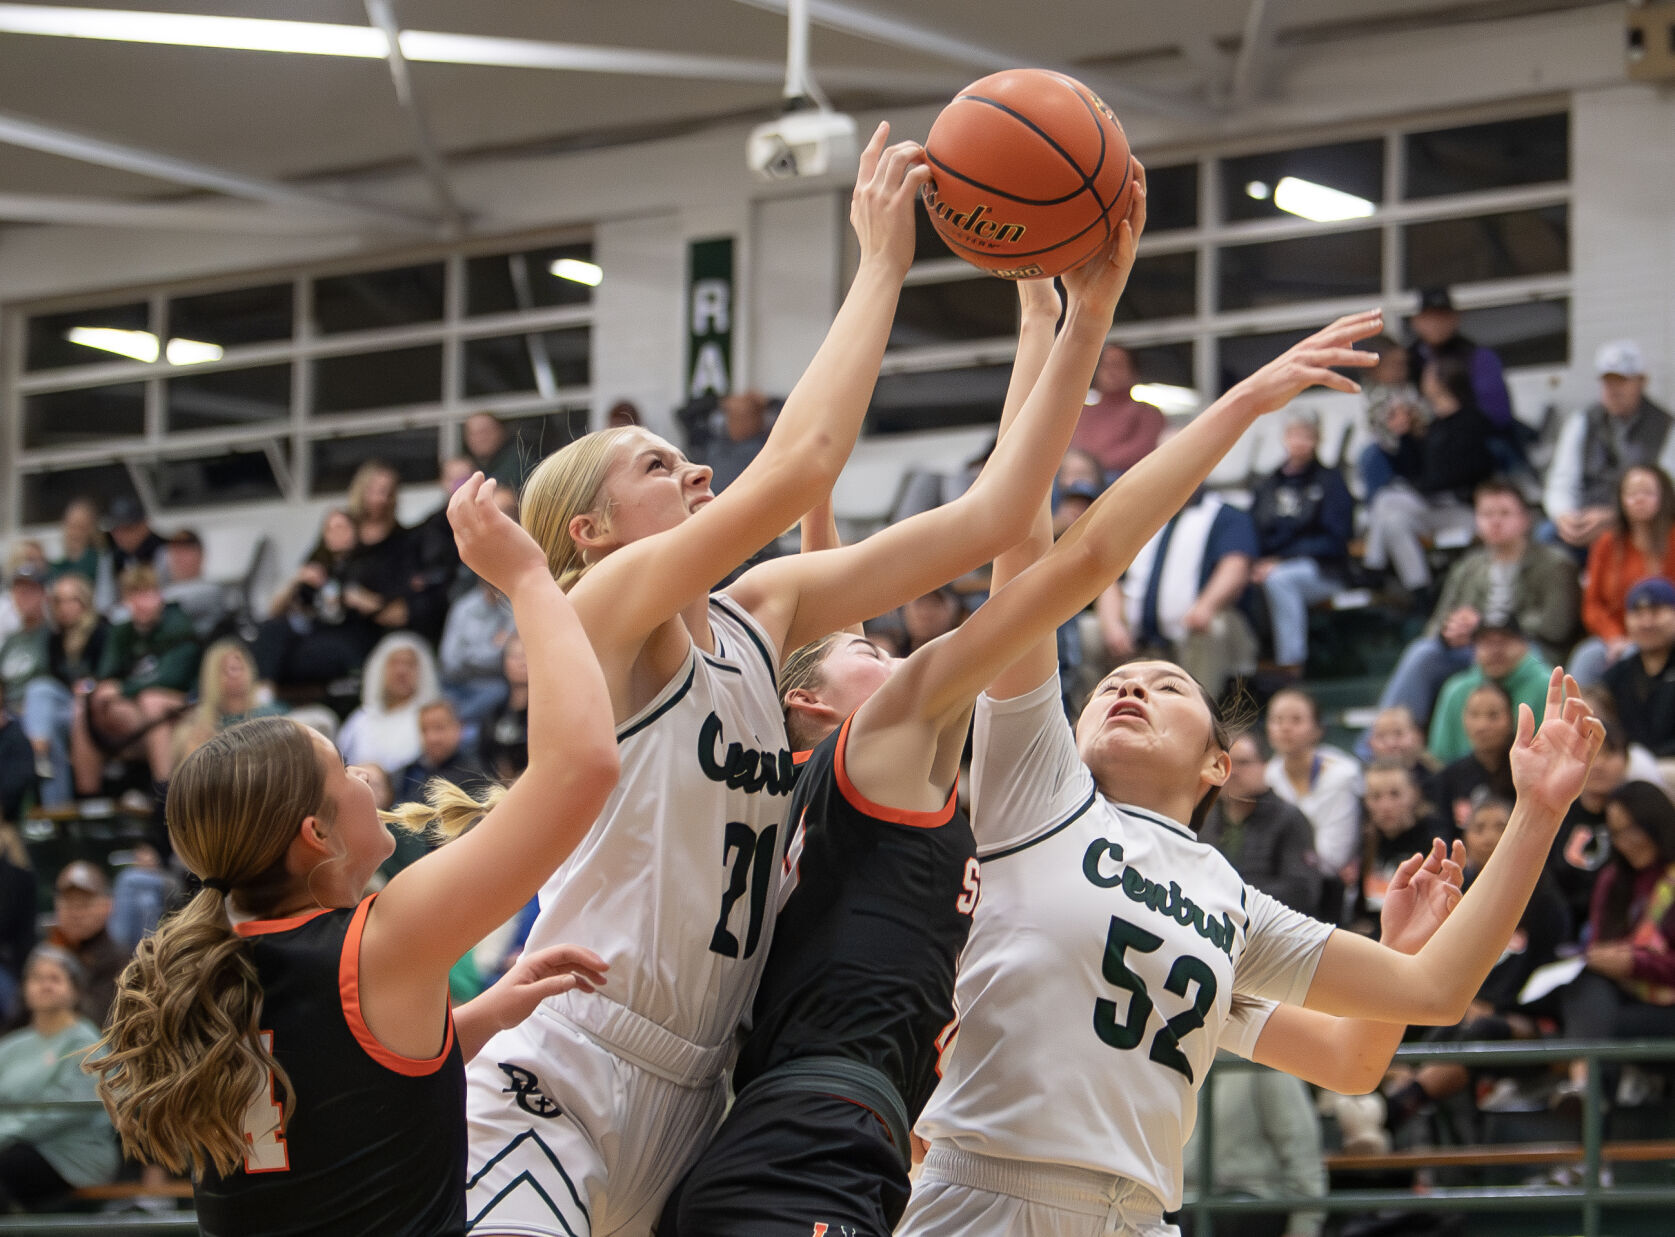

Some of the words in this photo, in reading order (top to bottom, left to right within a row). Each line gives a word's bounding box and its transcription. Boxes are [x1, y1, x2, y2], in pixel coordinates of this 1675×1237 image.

[708, 821, 778, 961] 21
[956, 856, 982, 919] S
[1082, 837, 1236, 965] Central
[1093, 914, 1218, 1086] 52
